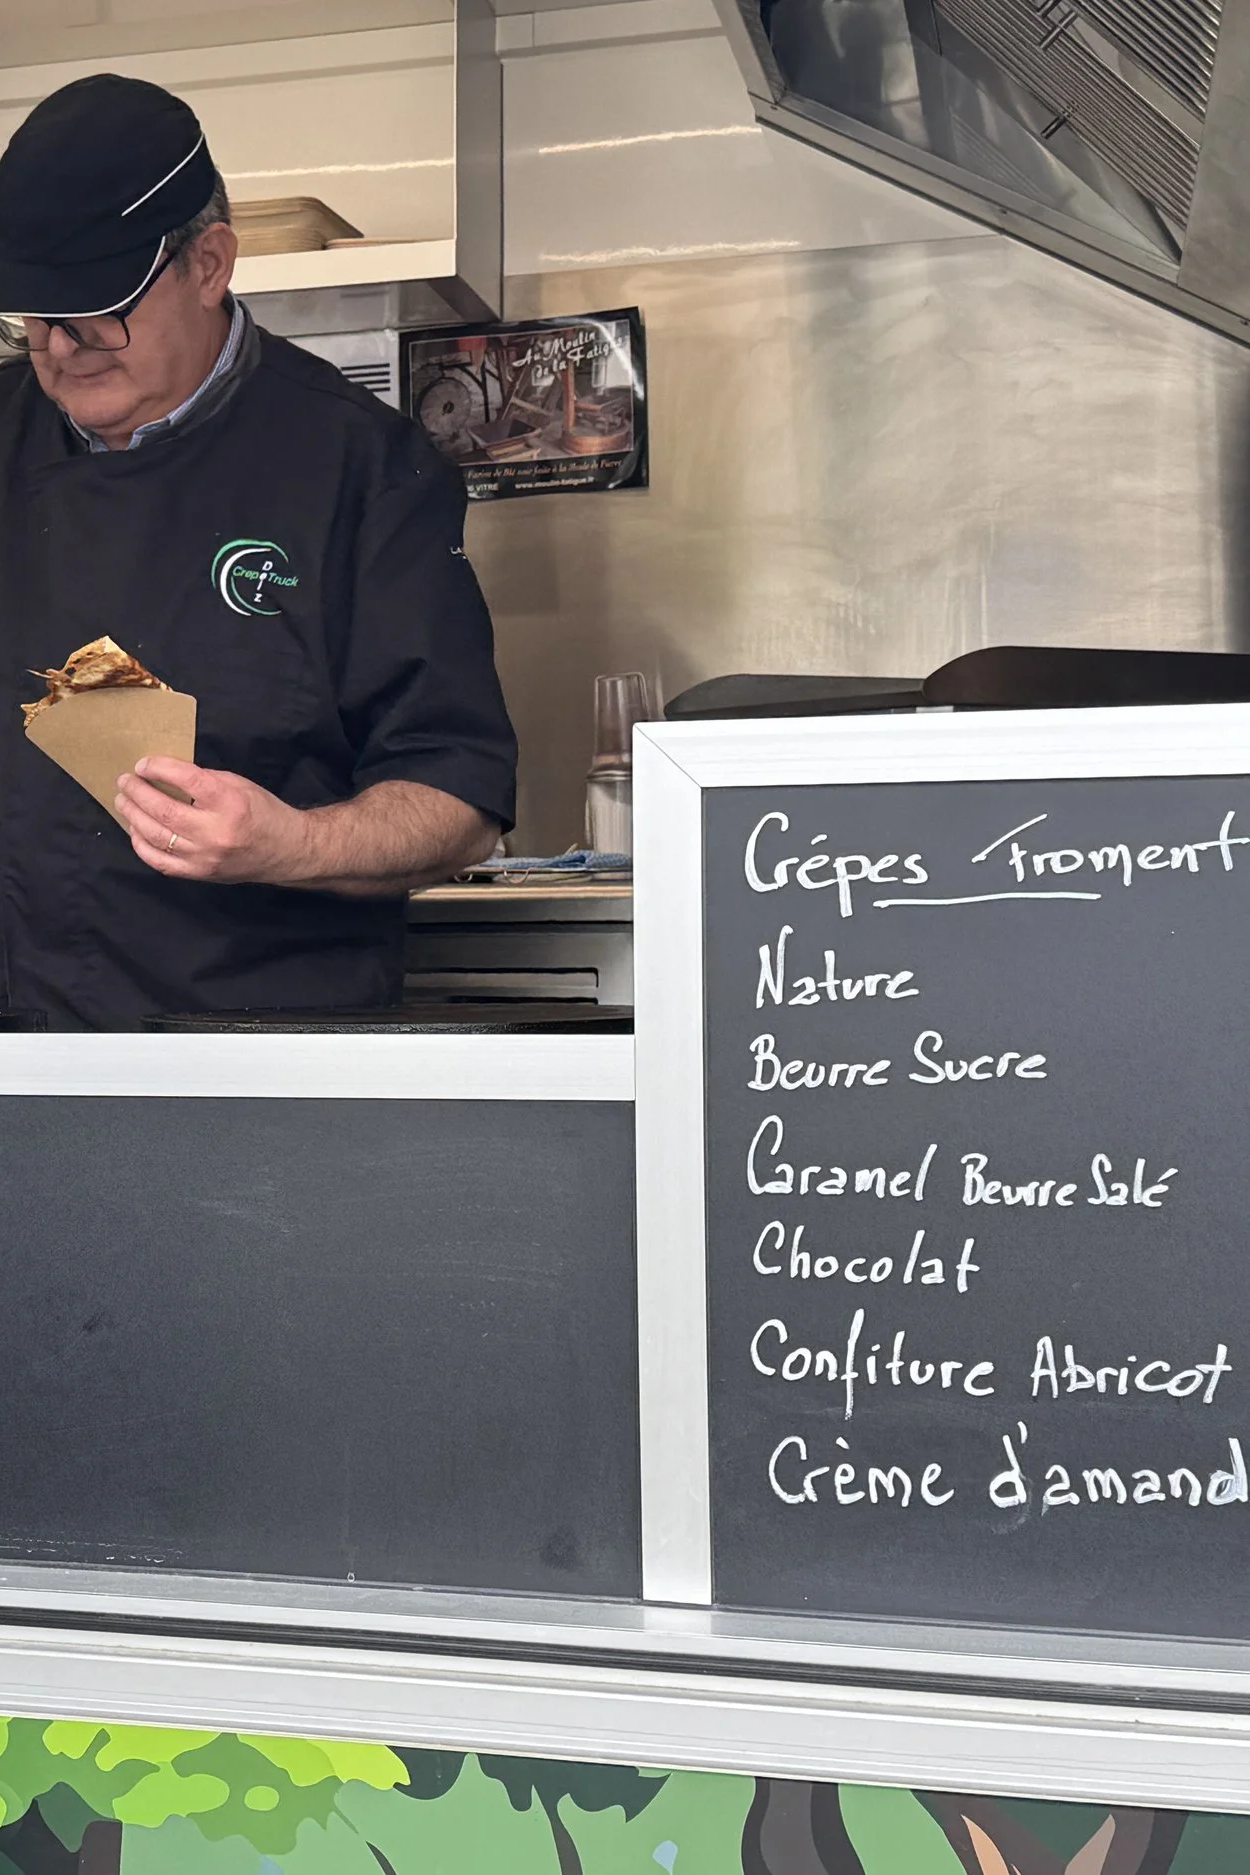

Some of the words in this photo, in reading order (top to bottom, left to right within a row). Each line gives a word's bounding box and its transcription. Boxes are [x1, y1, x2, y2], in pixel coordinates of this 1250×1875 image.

[512, 348, 541, 367] Au
[542, 331, 595, 361] Moulin
[553, 359, 567, 372] la
[268, 572, 299, 587] Truck
[755, 924, 920, 1009] Nature
[747, 1033, 892, 1092] Beurre
[908, 1030, 1048, 1084] Sucre
[747, 1114, 938, 1201] Caramel
[960, 1152, 1078, 1207] Beurre
[1087, 1153, 1179, 1208] Salé
[752, 1220, 981, 1294] Chocolat
[750, 1308, 996, 1420] Confiture
[1030, 1335, 1233, 1404] Abricot
[768, 1435, 955, 1508] Crème
[989, 1420, 1250, 1508] d'amand
